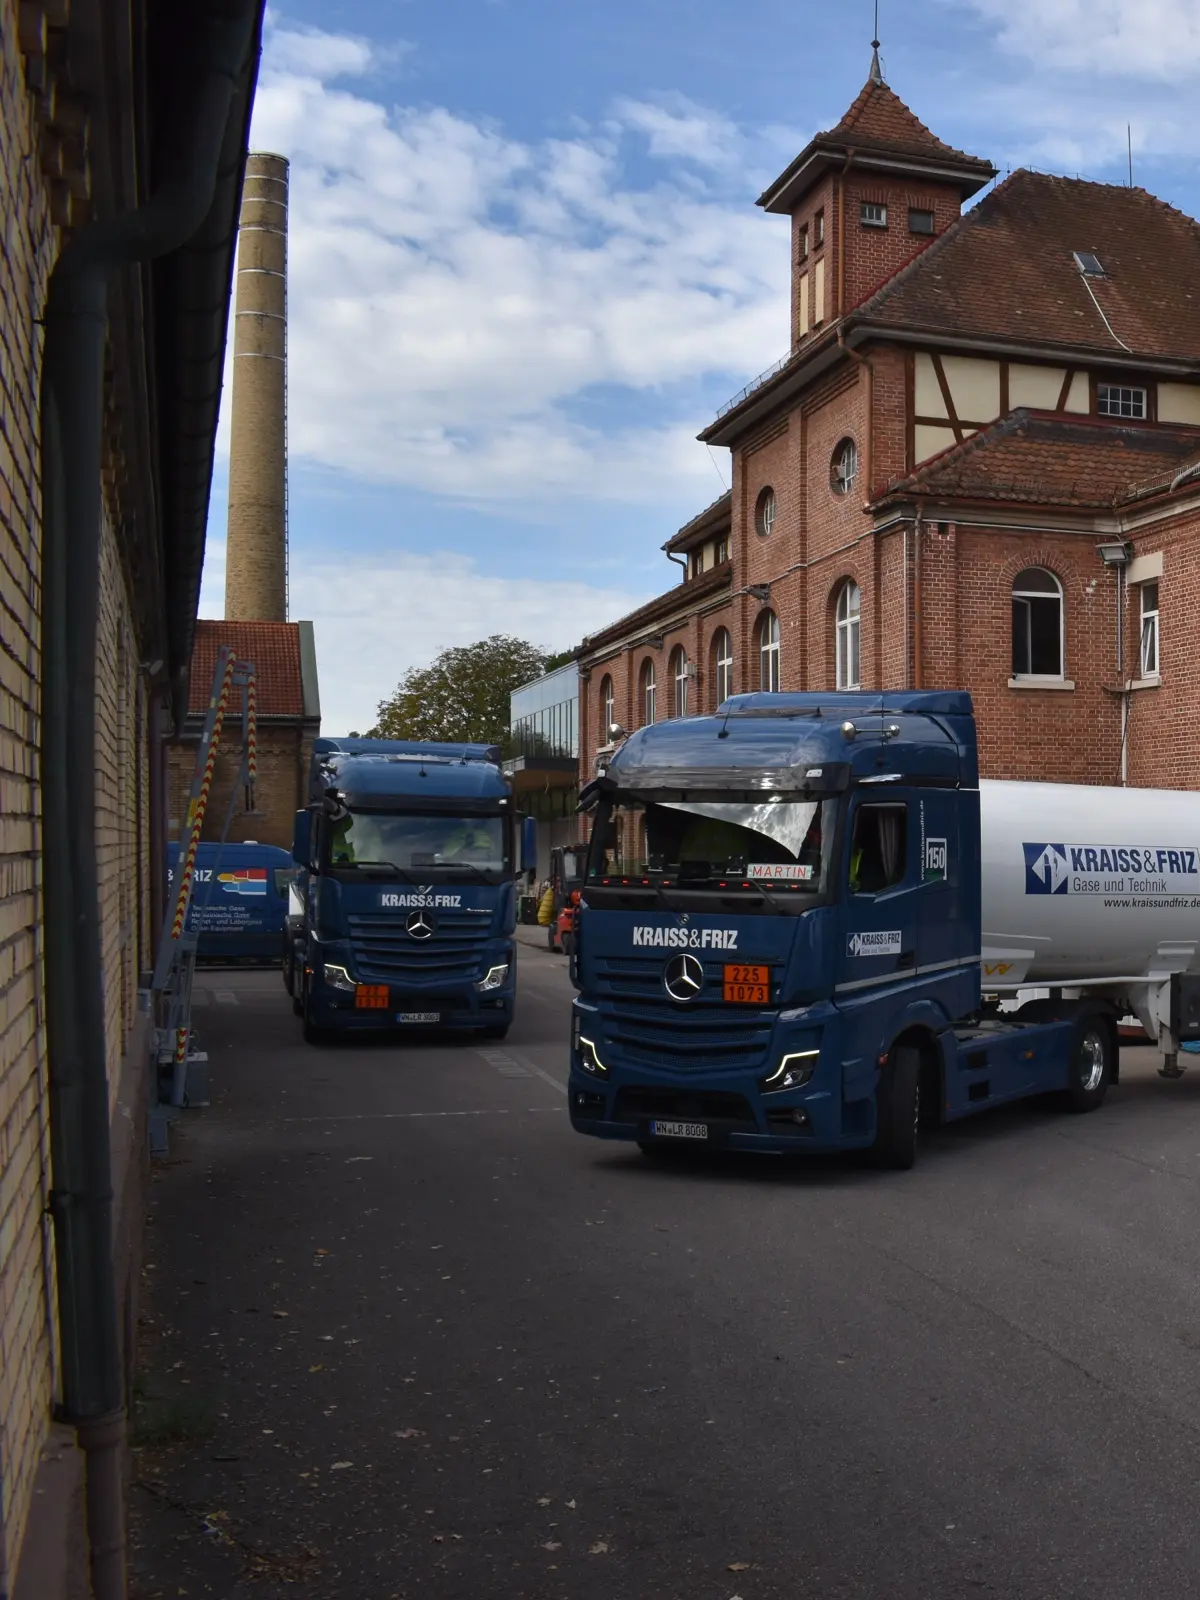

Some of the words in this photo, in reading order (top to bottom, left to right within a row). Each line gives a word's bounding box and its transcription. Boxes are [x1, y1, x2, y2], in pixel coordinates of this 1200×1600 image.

[928, 847, 945, 869] 150
[1070, 848, 1198, 874] KRAISS&FRIZ
[752, 865, 807, 878] MARTIN
[1073, 877, 1100, 892] Gase
[1104, 879, 1124, 892] und
[1128, 877, 1167, 893] Technik
[382, 894, 461, 907] KRAISS&FRIZ
[633, 927, 738, 949] KRAISS&FRIZ
[733, 967, 760, 982] 225
[729, 985, 764, 1000] 1073
[673, 1123, 684, 1135] LR
